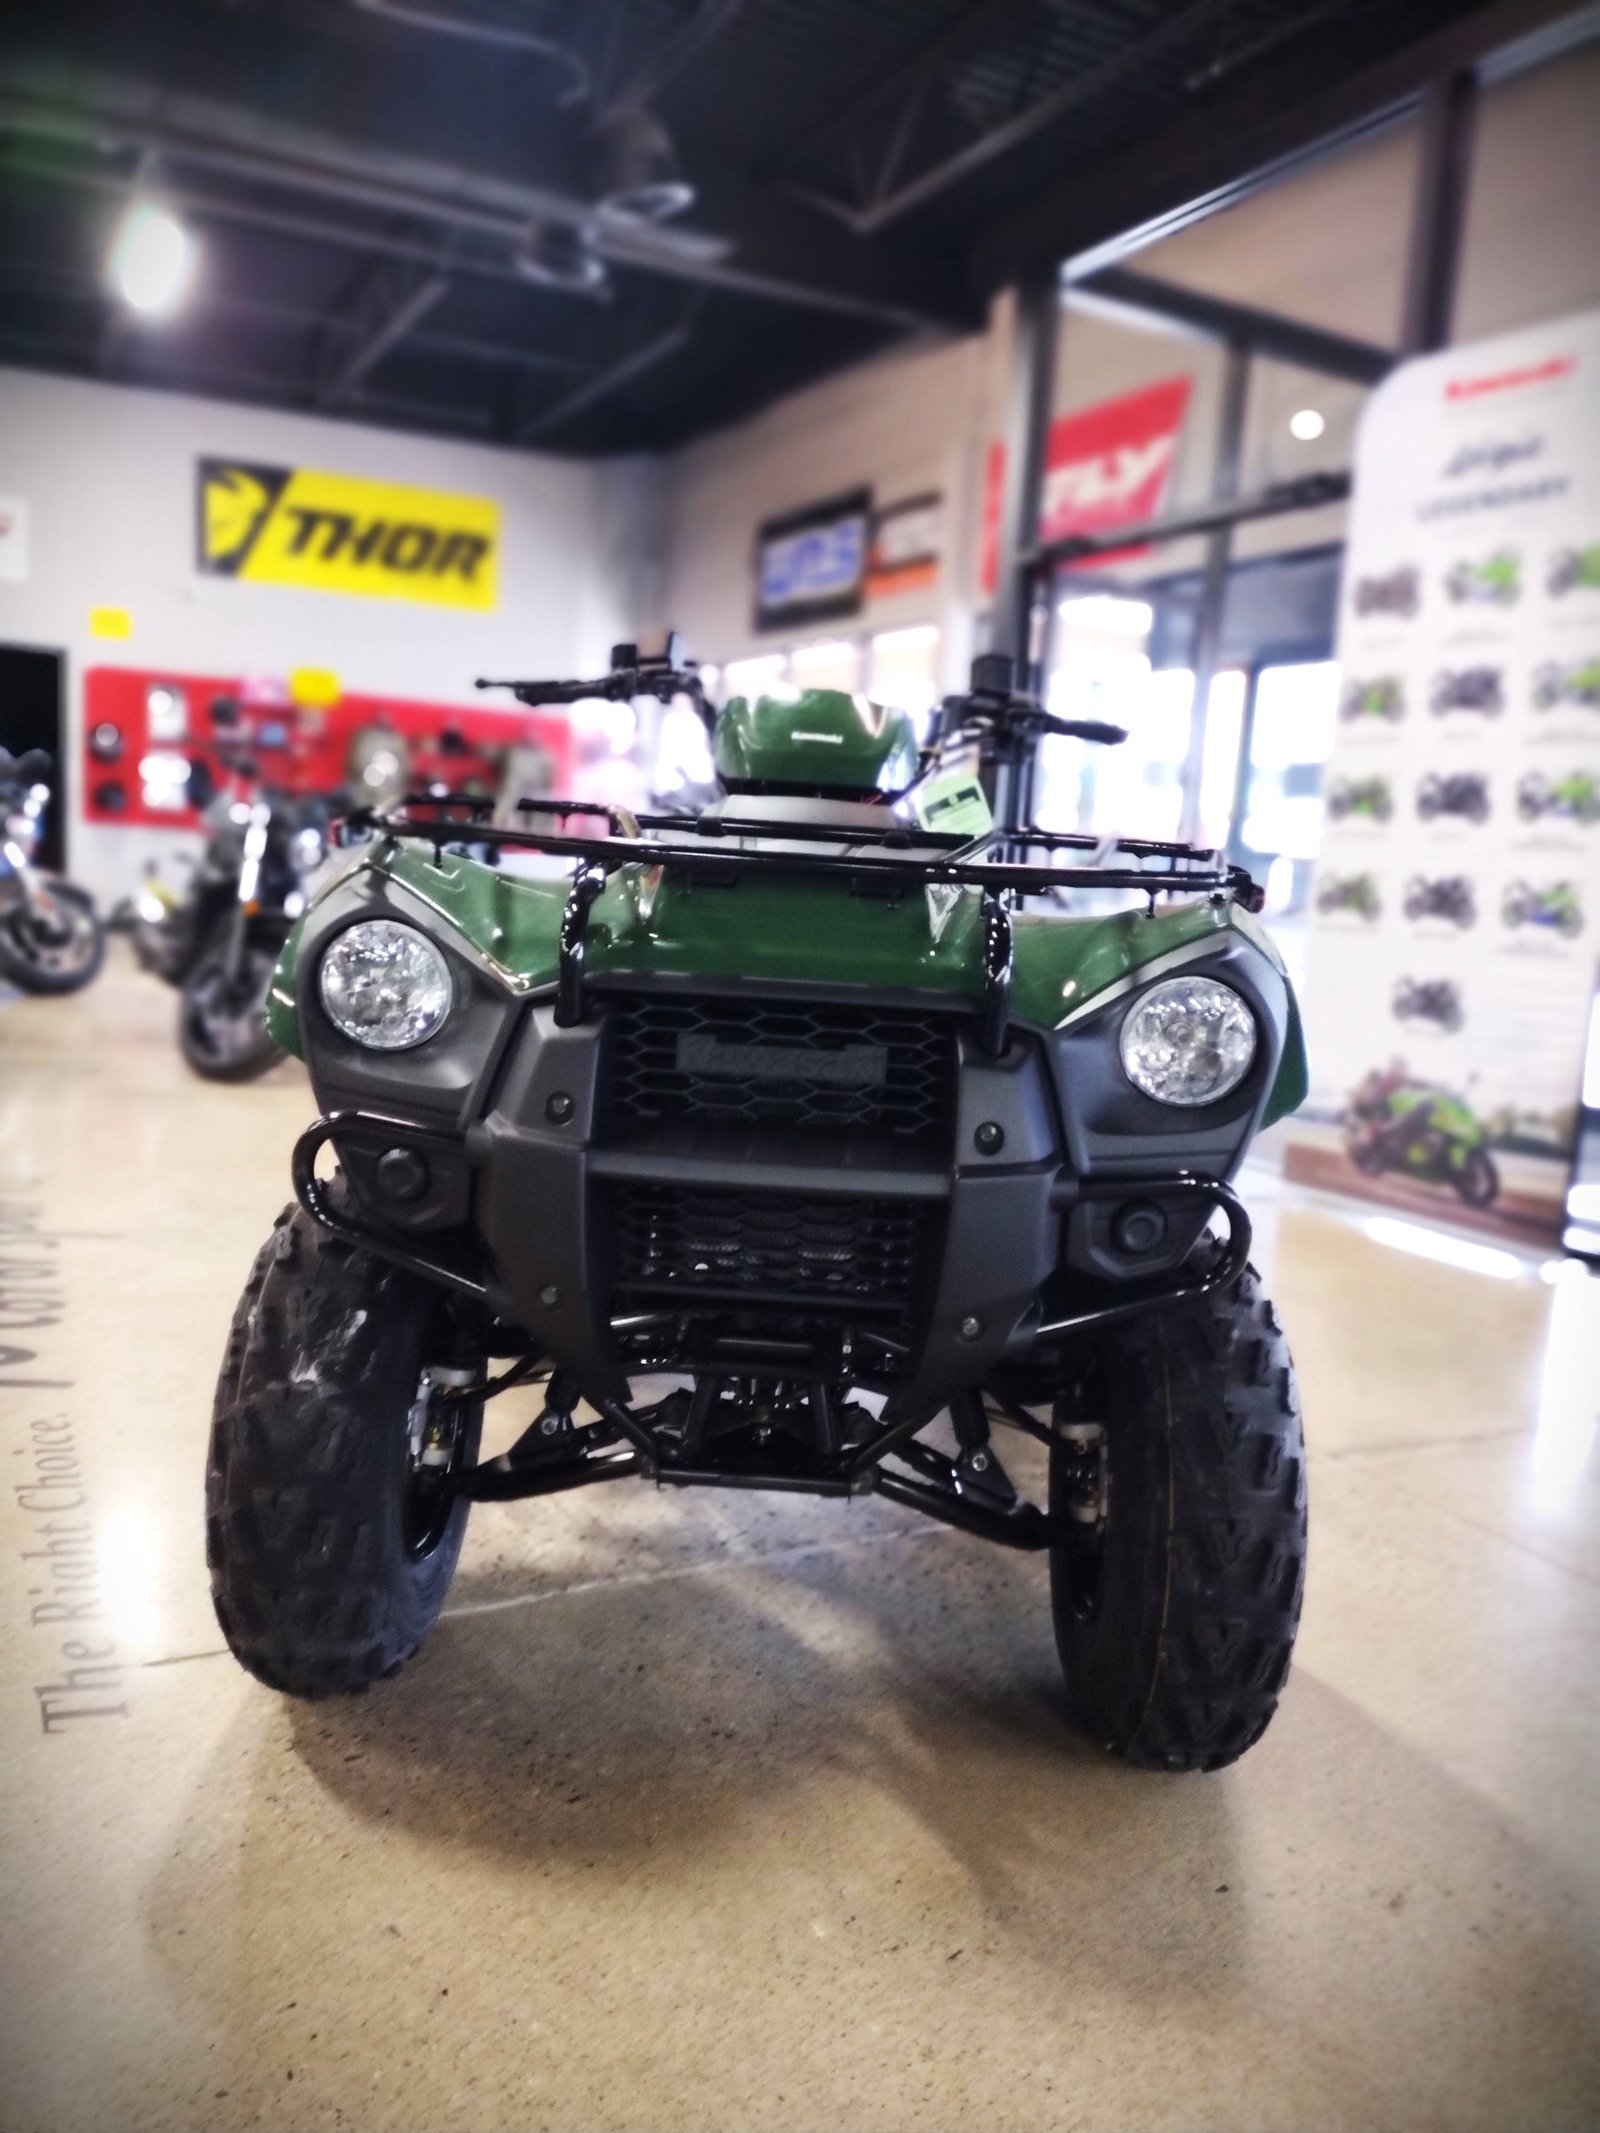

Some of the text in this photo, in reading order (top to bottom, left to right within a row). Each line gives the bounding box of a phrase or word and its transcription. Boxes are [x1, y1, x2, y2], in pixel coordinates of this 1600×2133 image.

[287, 507, 490, 582] THOR
[12, 1411, 86, 1512] Choice.
[33, 1638, 128, 1735] The
